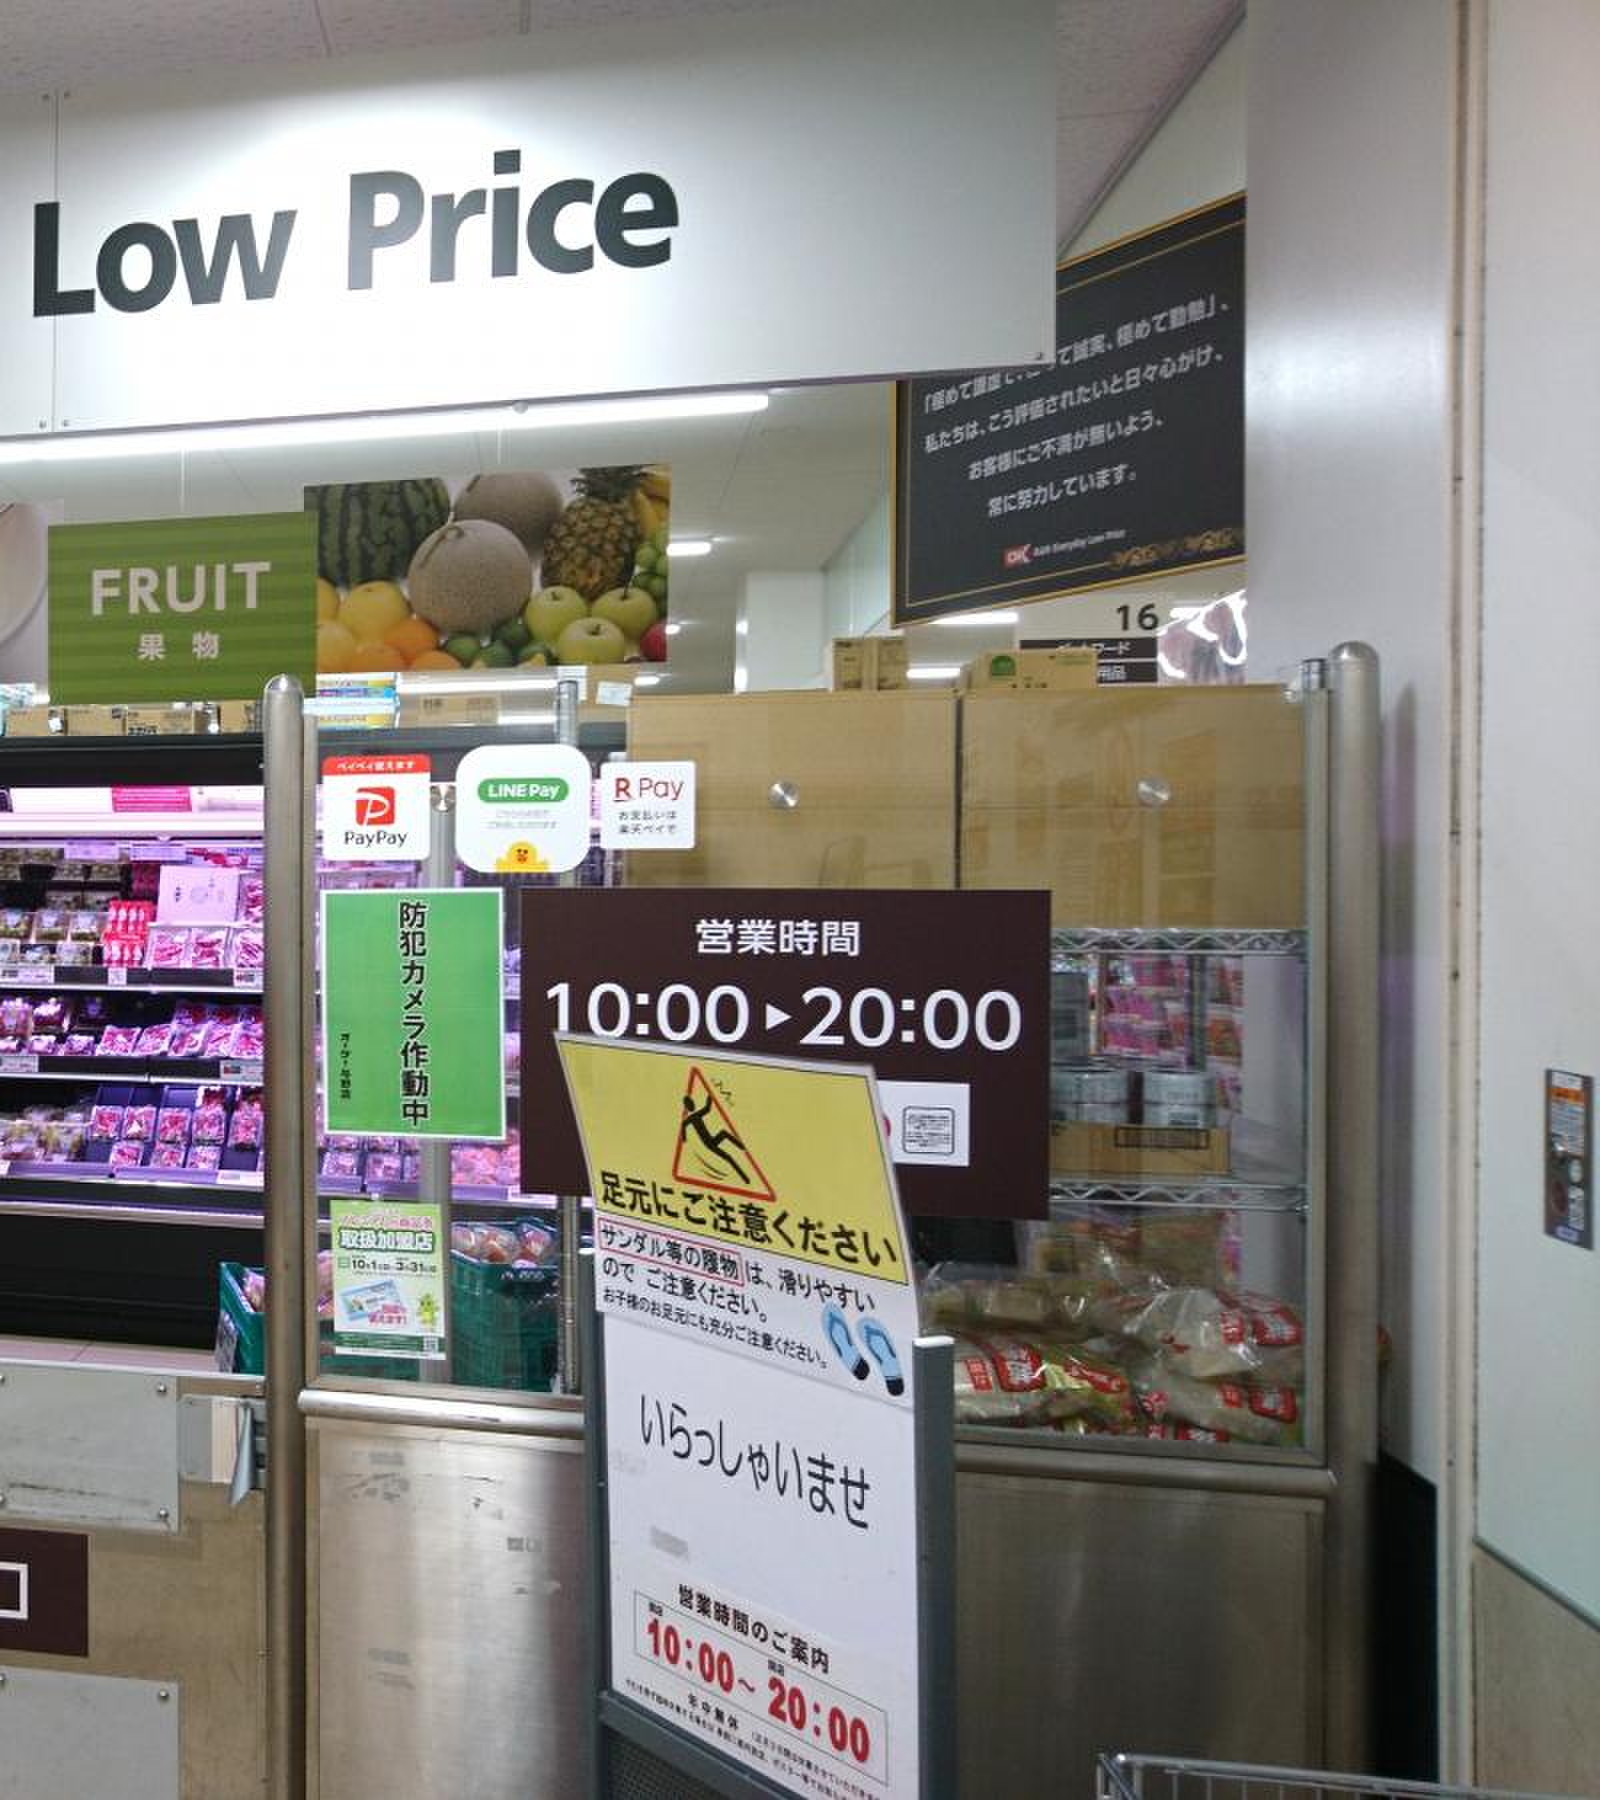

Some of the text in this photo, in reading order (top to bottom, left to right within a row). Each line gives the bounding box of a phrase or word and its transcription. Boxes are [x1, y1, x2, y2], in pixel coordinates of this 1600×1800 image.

[32, 200, 297, 317] Low
[347, 149, 680, 292] Price
[91, 562, 272, 615] FRUIT
[1116, 604, 1159, 631] 16
[137, 631, 220, 660] 果物
[488, 783, 560, 803] LINE Pay
[615, 776, 684, 803] R Pay
[344, 830, 408, 847] PayPay
[695, 918, 861, 957] 営業時間
[399, 902, 428, 1127] 防犯カメラ作動中
[546, 982, 1022, 1052] 10:00 20:00
[600, 1171, 897, 1267] 足元にご注意ください
[602, 1288, 829, 1369] お子様のお足元にも充分ご注意ください。
[640, 1394, 870, 1530] いらっしゃいませ
[678, 1583, 830, 1675] 営業時間のご案内
[767, 1677, 871, 1763] 20:00
